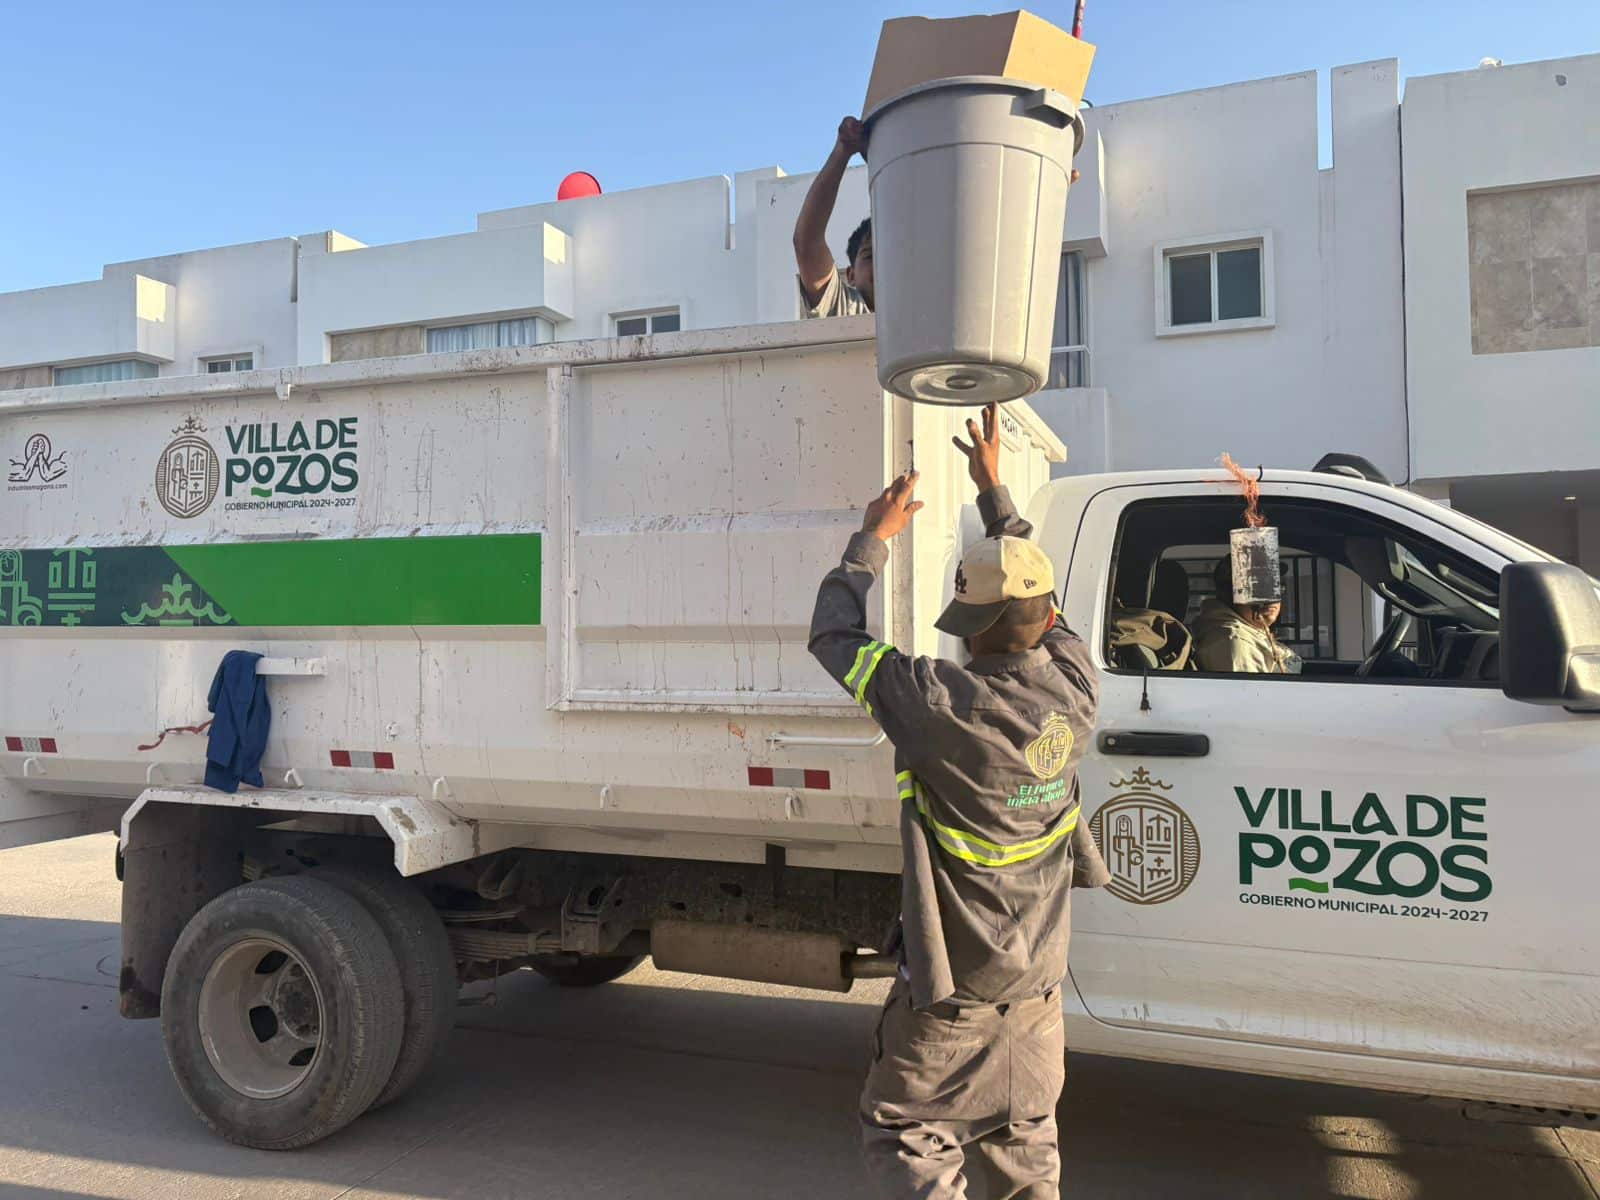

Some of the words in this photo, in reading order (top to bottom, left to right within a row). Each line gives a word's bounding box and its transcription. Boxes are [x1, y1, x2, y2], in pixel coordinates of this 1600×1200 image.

[225, 421, 311, 454] VILLA
[315, 417, 358, 449] DE
[225, 451, 359, 497] POZOS
[224, 502, 265, 511] GOBIERNO
[266, 500, 308, 510] MUNICIPAL
[309, 498, 356, 508] 2024-2027
[1233, 786, 1399, 836] VILLA
[1405, 794, 1488, 841] DE
[1238, 831, 1493, 903] POZOS
[1239, 893, 1316, 909] GOBIERNO
[1318, 899, 1398, 916] MUNICIPAL
[1400, 905, 1489, 922] 2024-2027
